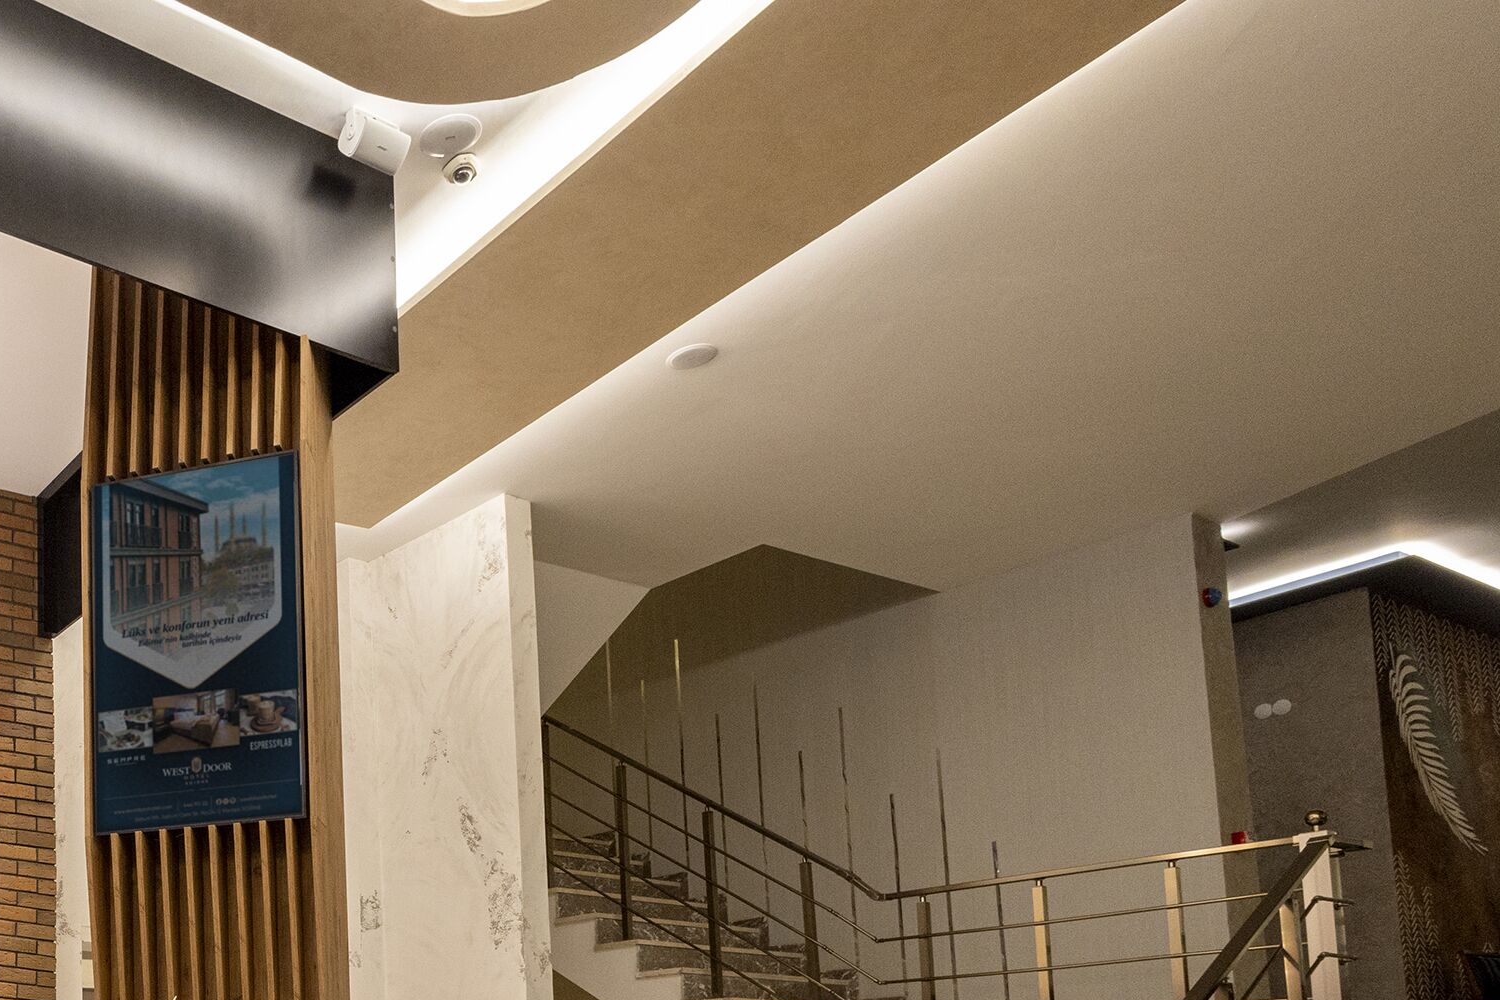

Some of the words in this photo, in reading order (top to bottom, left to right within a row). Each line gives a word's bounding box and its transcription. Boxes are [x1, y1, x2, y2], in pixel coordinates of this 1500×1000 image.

[122, 627, 146, 639] Lüks
[149, 627, 160, 635] ve
[163, 620, 210, 633] konforun
[212, 616, 235, 630] yeni
[237, 609, 269, 624] adresi
[180, 631, 211, 642] kalbinde
[182, 638, 207, 648] tarihin
[209, 634, 242, 646] içindeyiz
[107, 754, 146, 765] SEMPRE
[162, 766, 190, 777] WEST
[203, 762, 232, 772] DOOR
